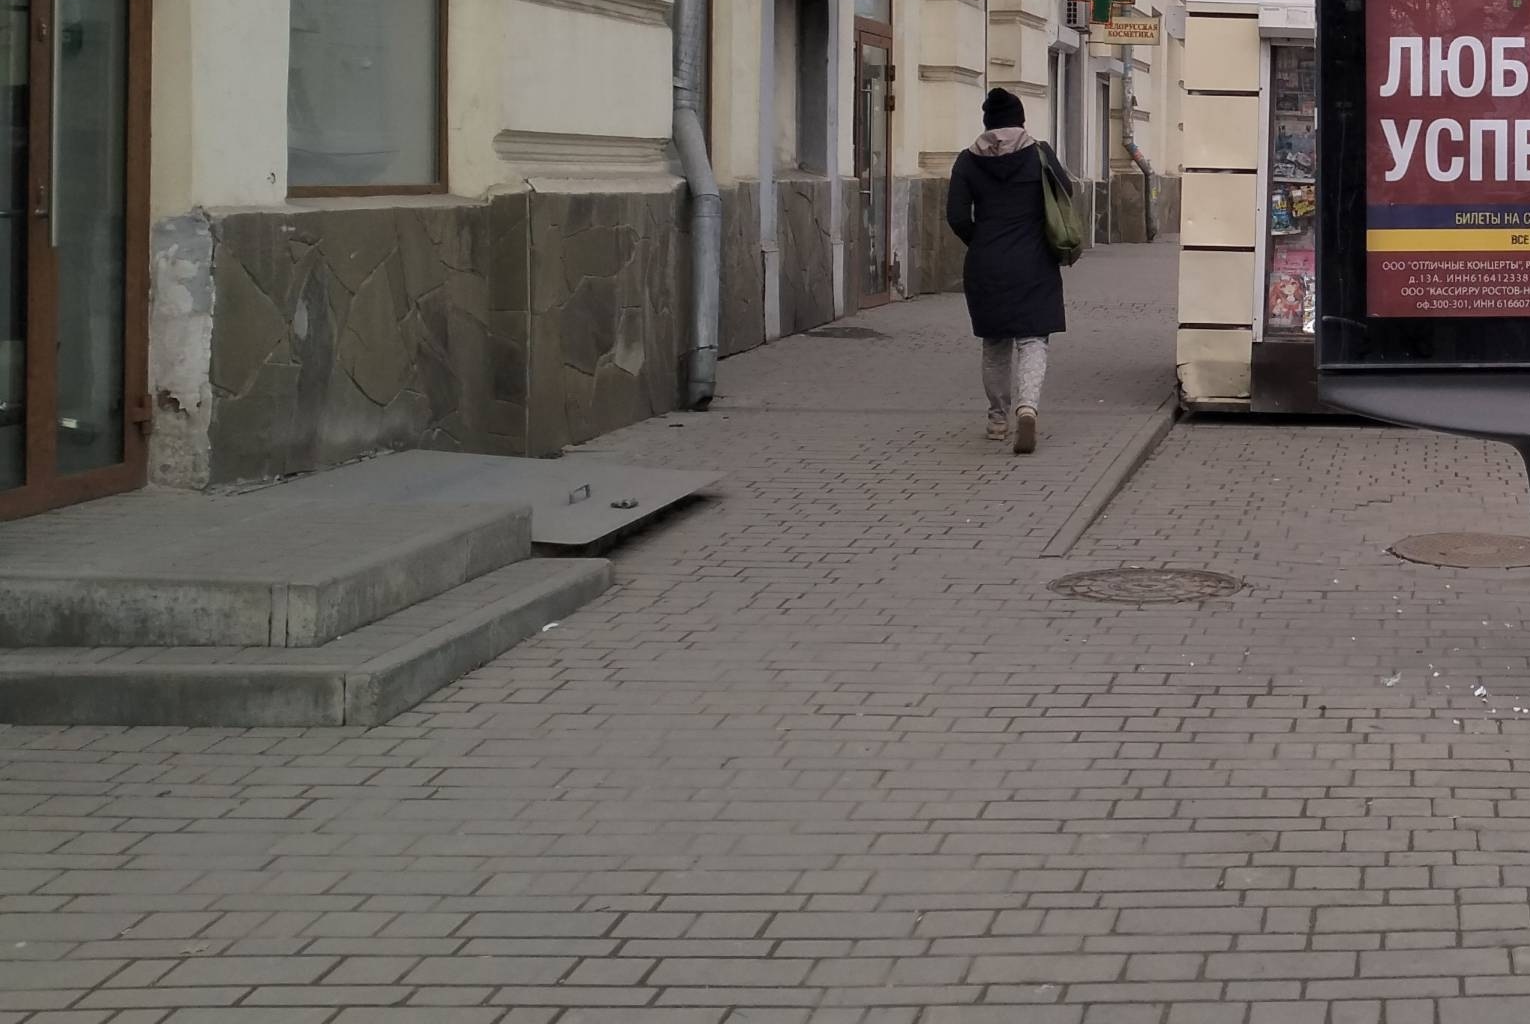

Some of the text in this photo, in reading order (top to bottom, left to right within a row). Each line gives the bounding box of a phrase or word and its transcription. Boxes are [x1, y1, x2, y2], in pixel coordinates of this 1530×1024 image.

[1455, 212, 1501, 225] БИЛЕТЫ
[1504, 212, 1519, 225] НА
[1511, 235, 1529, 245] ВСЕ
[1382, 261, 1405, 270] ООО
[1401, 287, 1424, 296] ООО
[1473, 299, 1494, 308] ИНН
